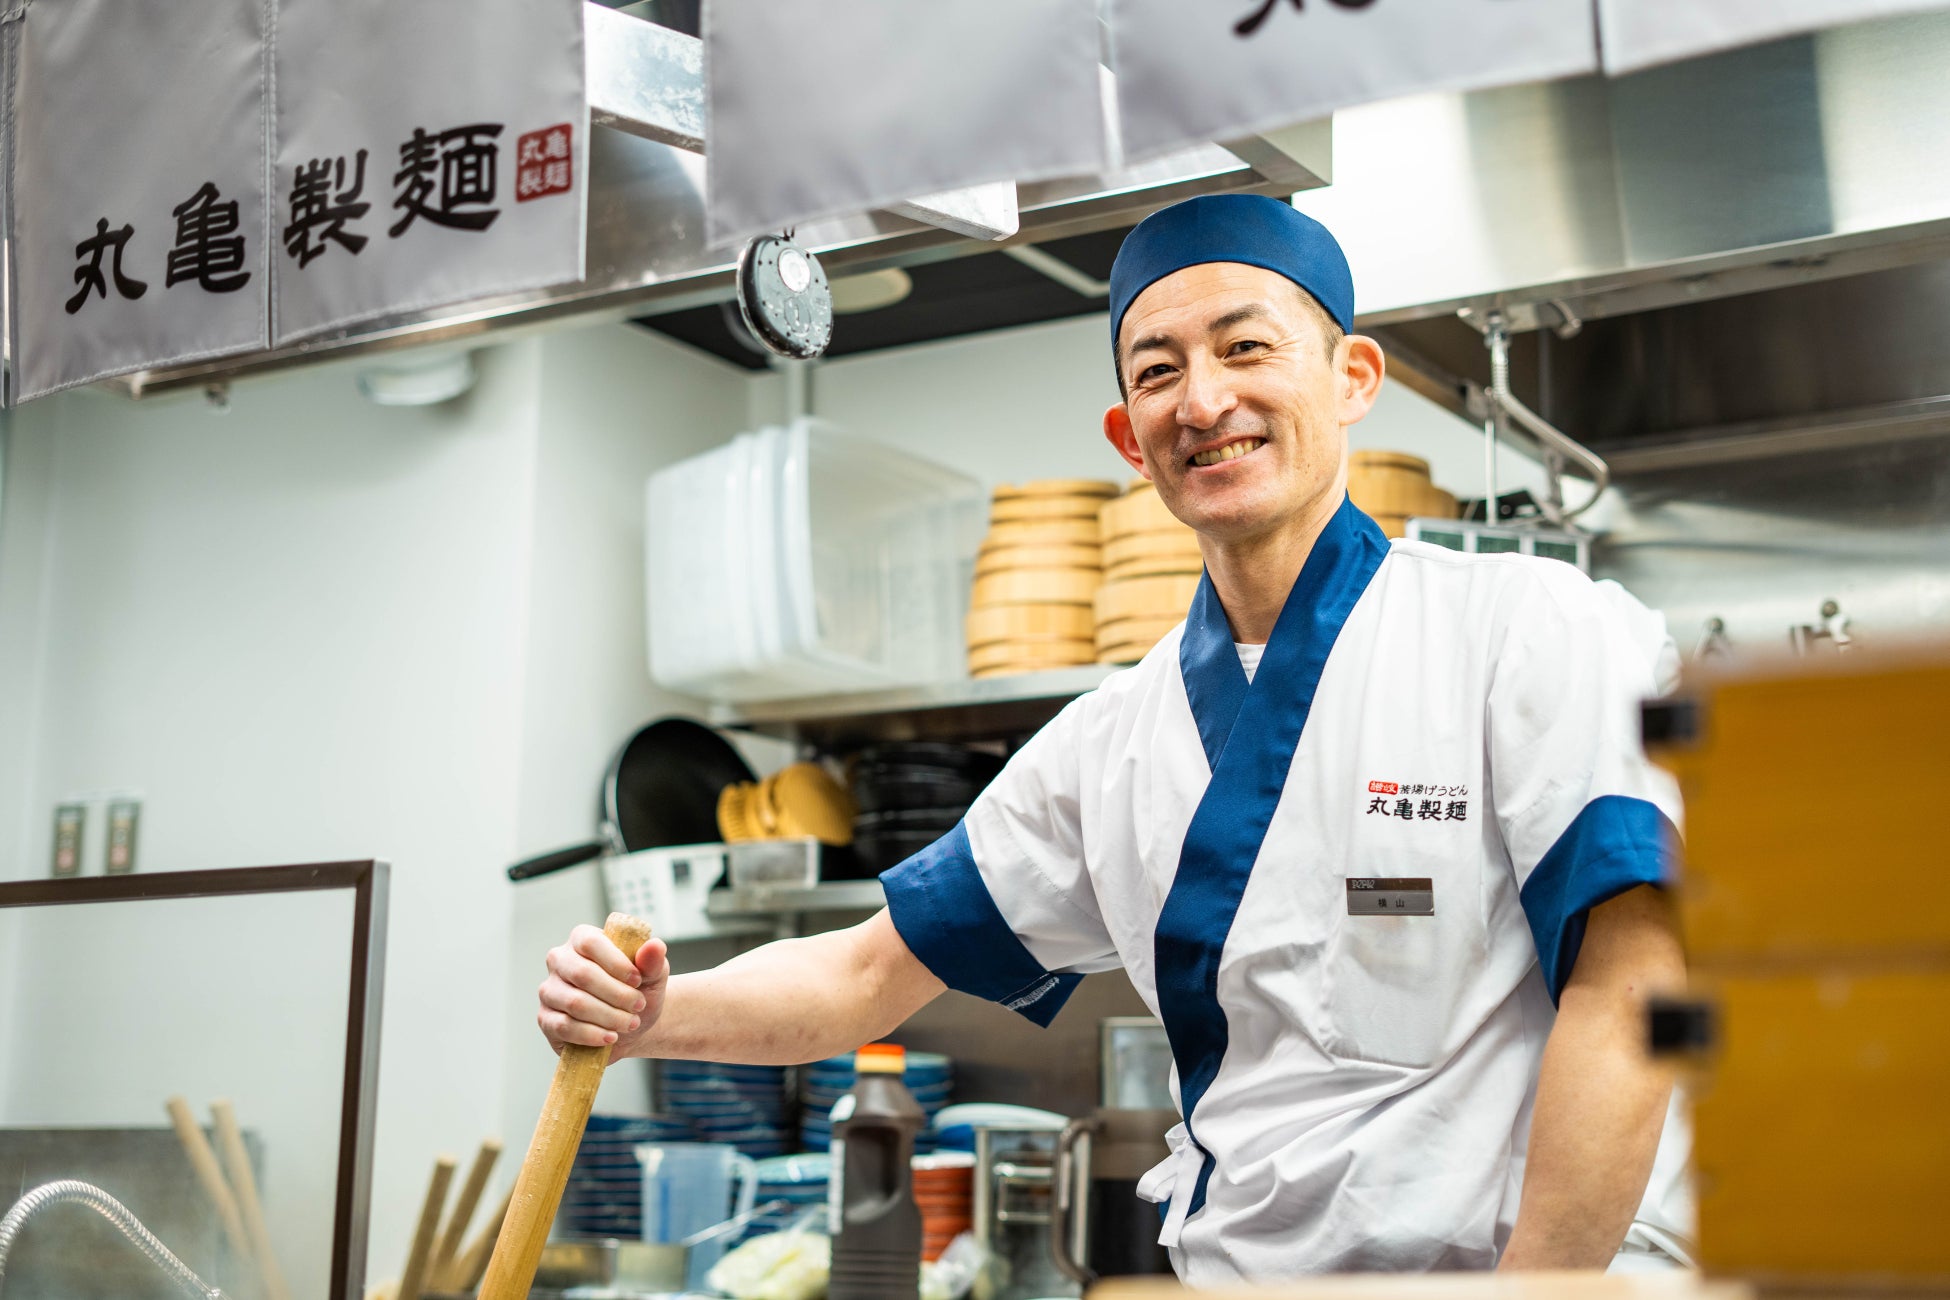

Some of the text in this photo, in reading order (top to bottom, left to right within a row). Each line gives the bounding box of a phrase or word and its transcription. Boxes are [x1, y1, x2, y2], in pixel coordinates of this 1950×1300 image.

[65, 124, 504, 315] 丸亀製麺
[1366, 797, 1468, 821] 丸亀製麺
